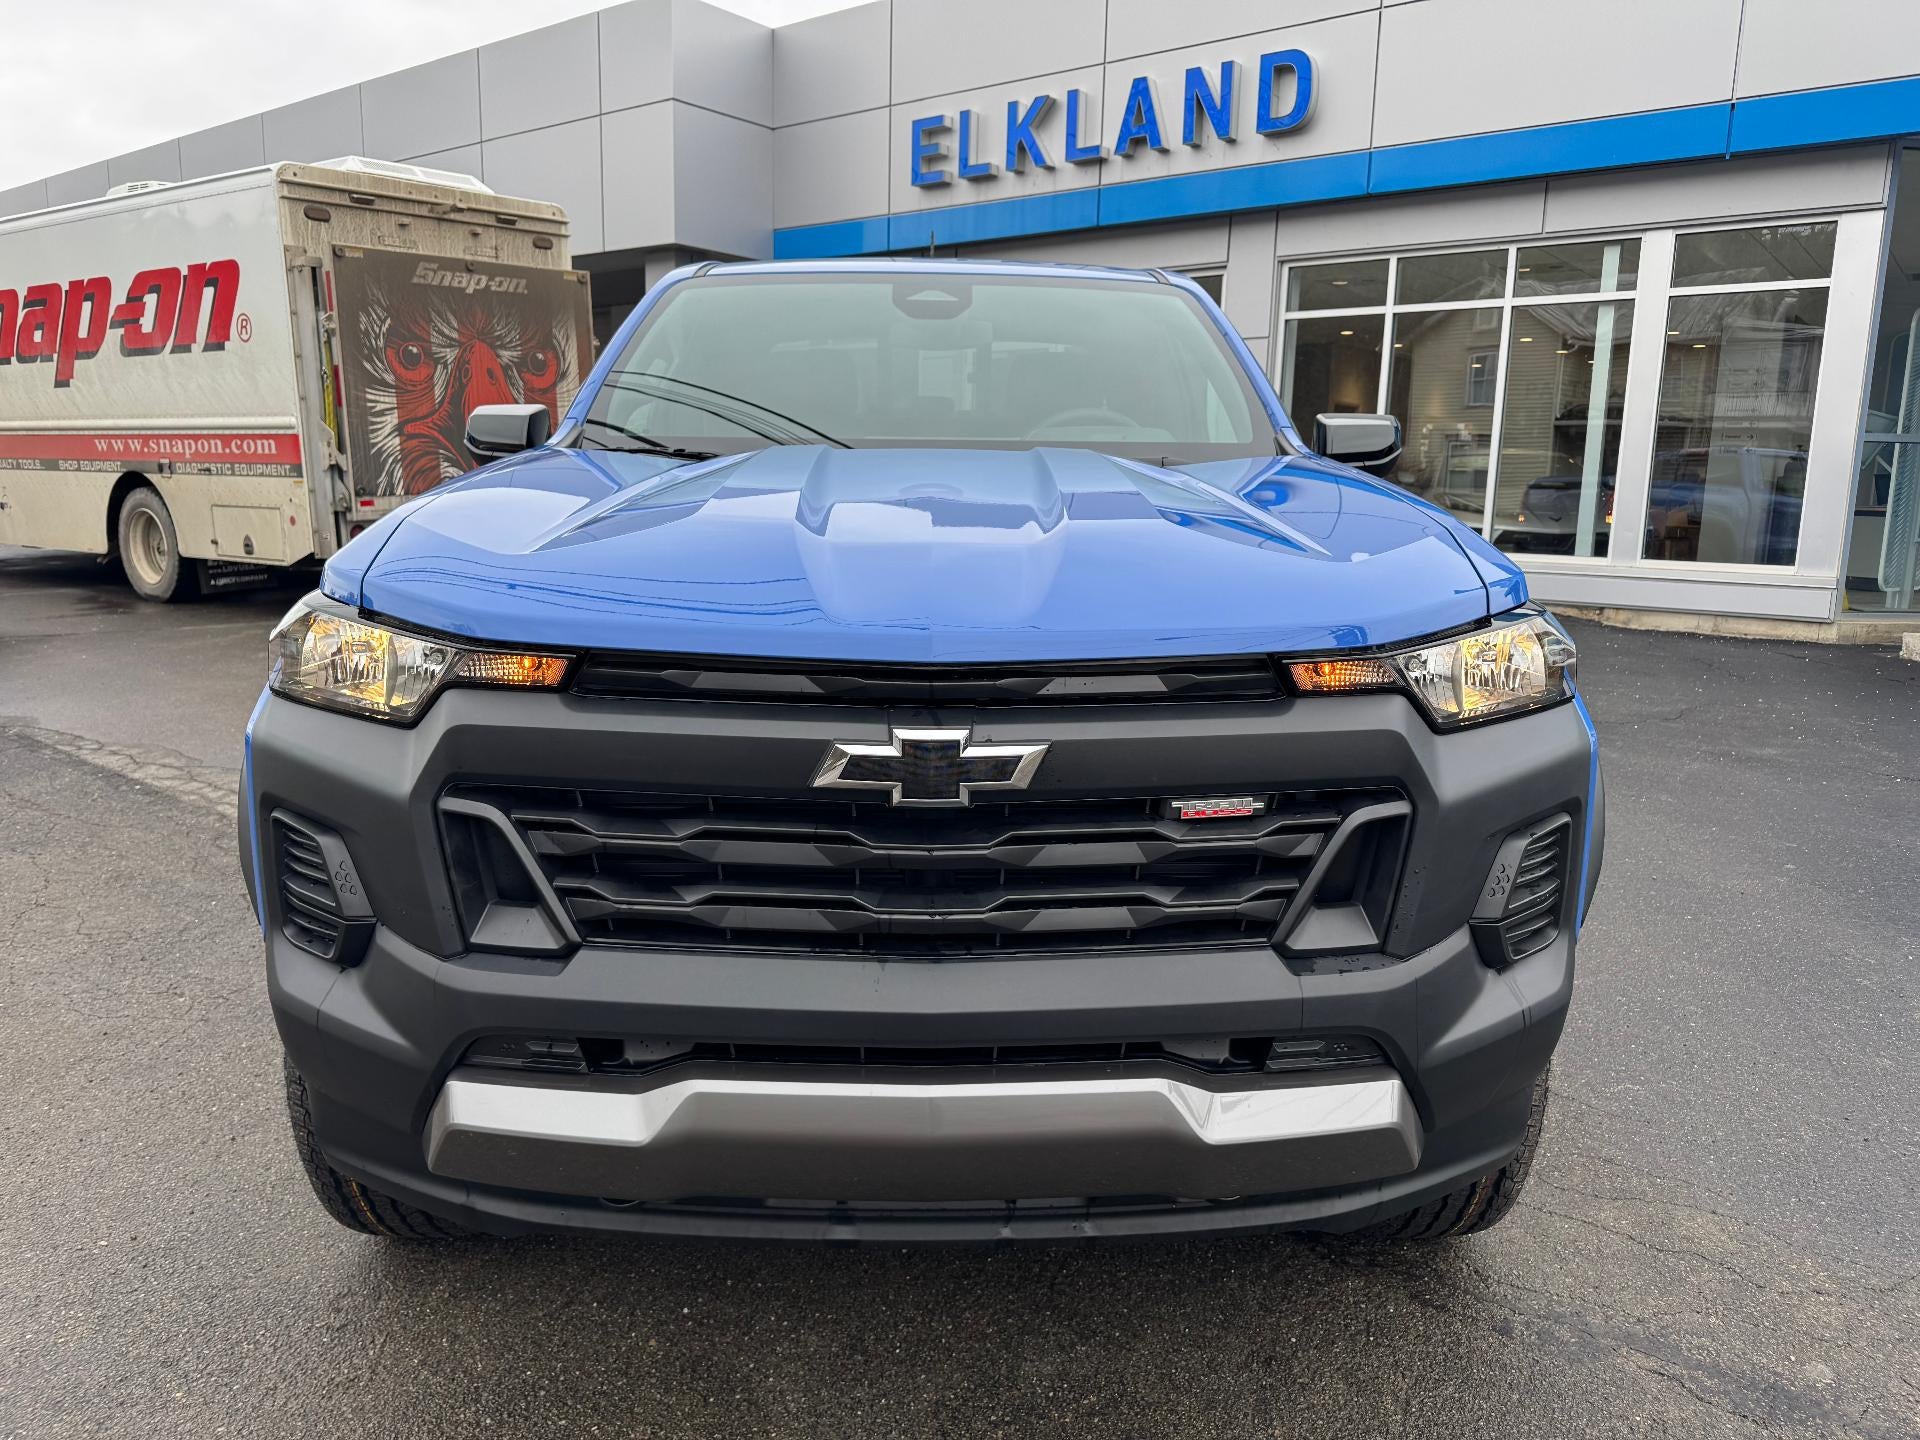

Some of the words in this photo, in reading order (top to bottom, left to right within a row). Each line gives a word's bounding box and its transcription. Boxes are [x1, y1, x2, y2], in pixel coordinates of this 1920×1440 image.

[911, 48, 1317, 188] ELKLAND
[94, 438, 278, 458] www.snapon.com
[58, 460, 78, 470] SHOP
[1171, 798, 1265, 811] TRAIL
